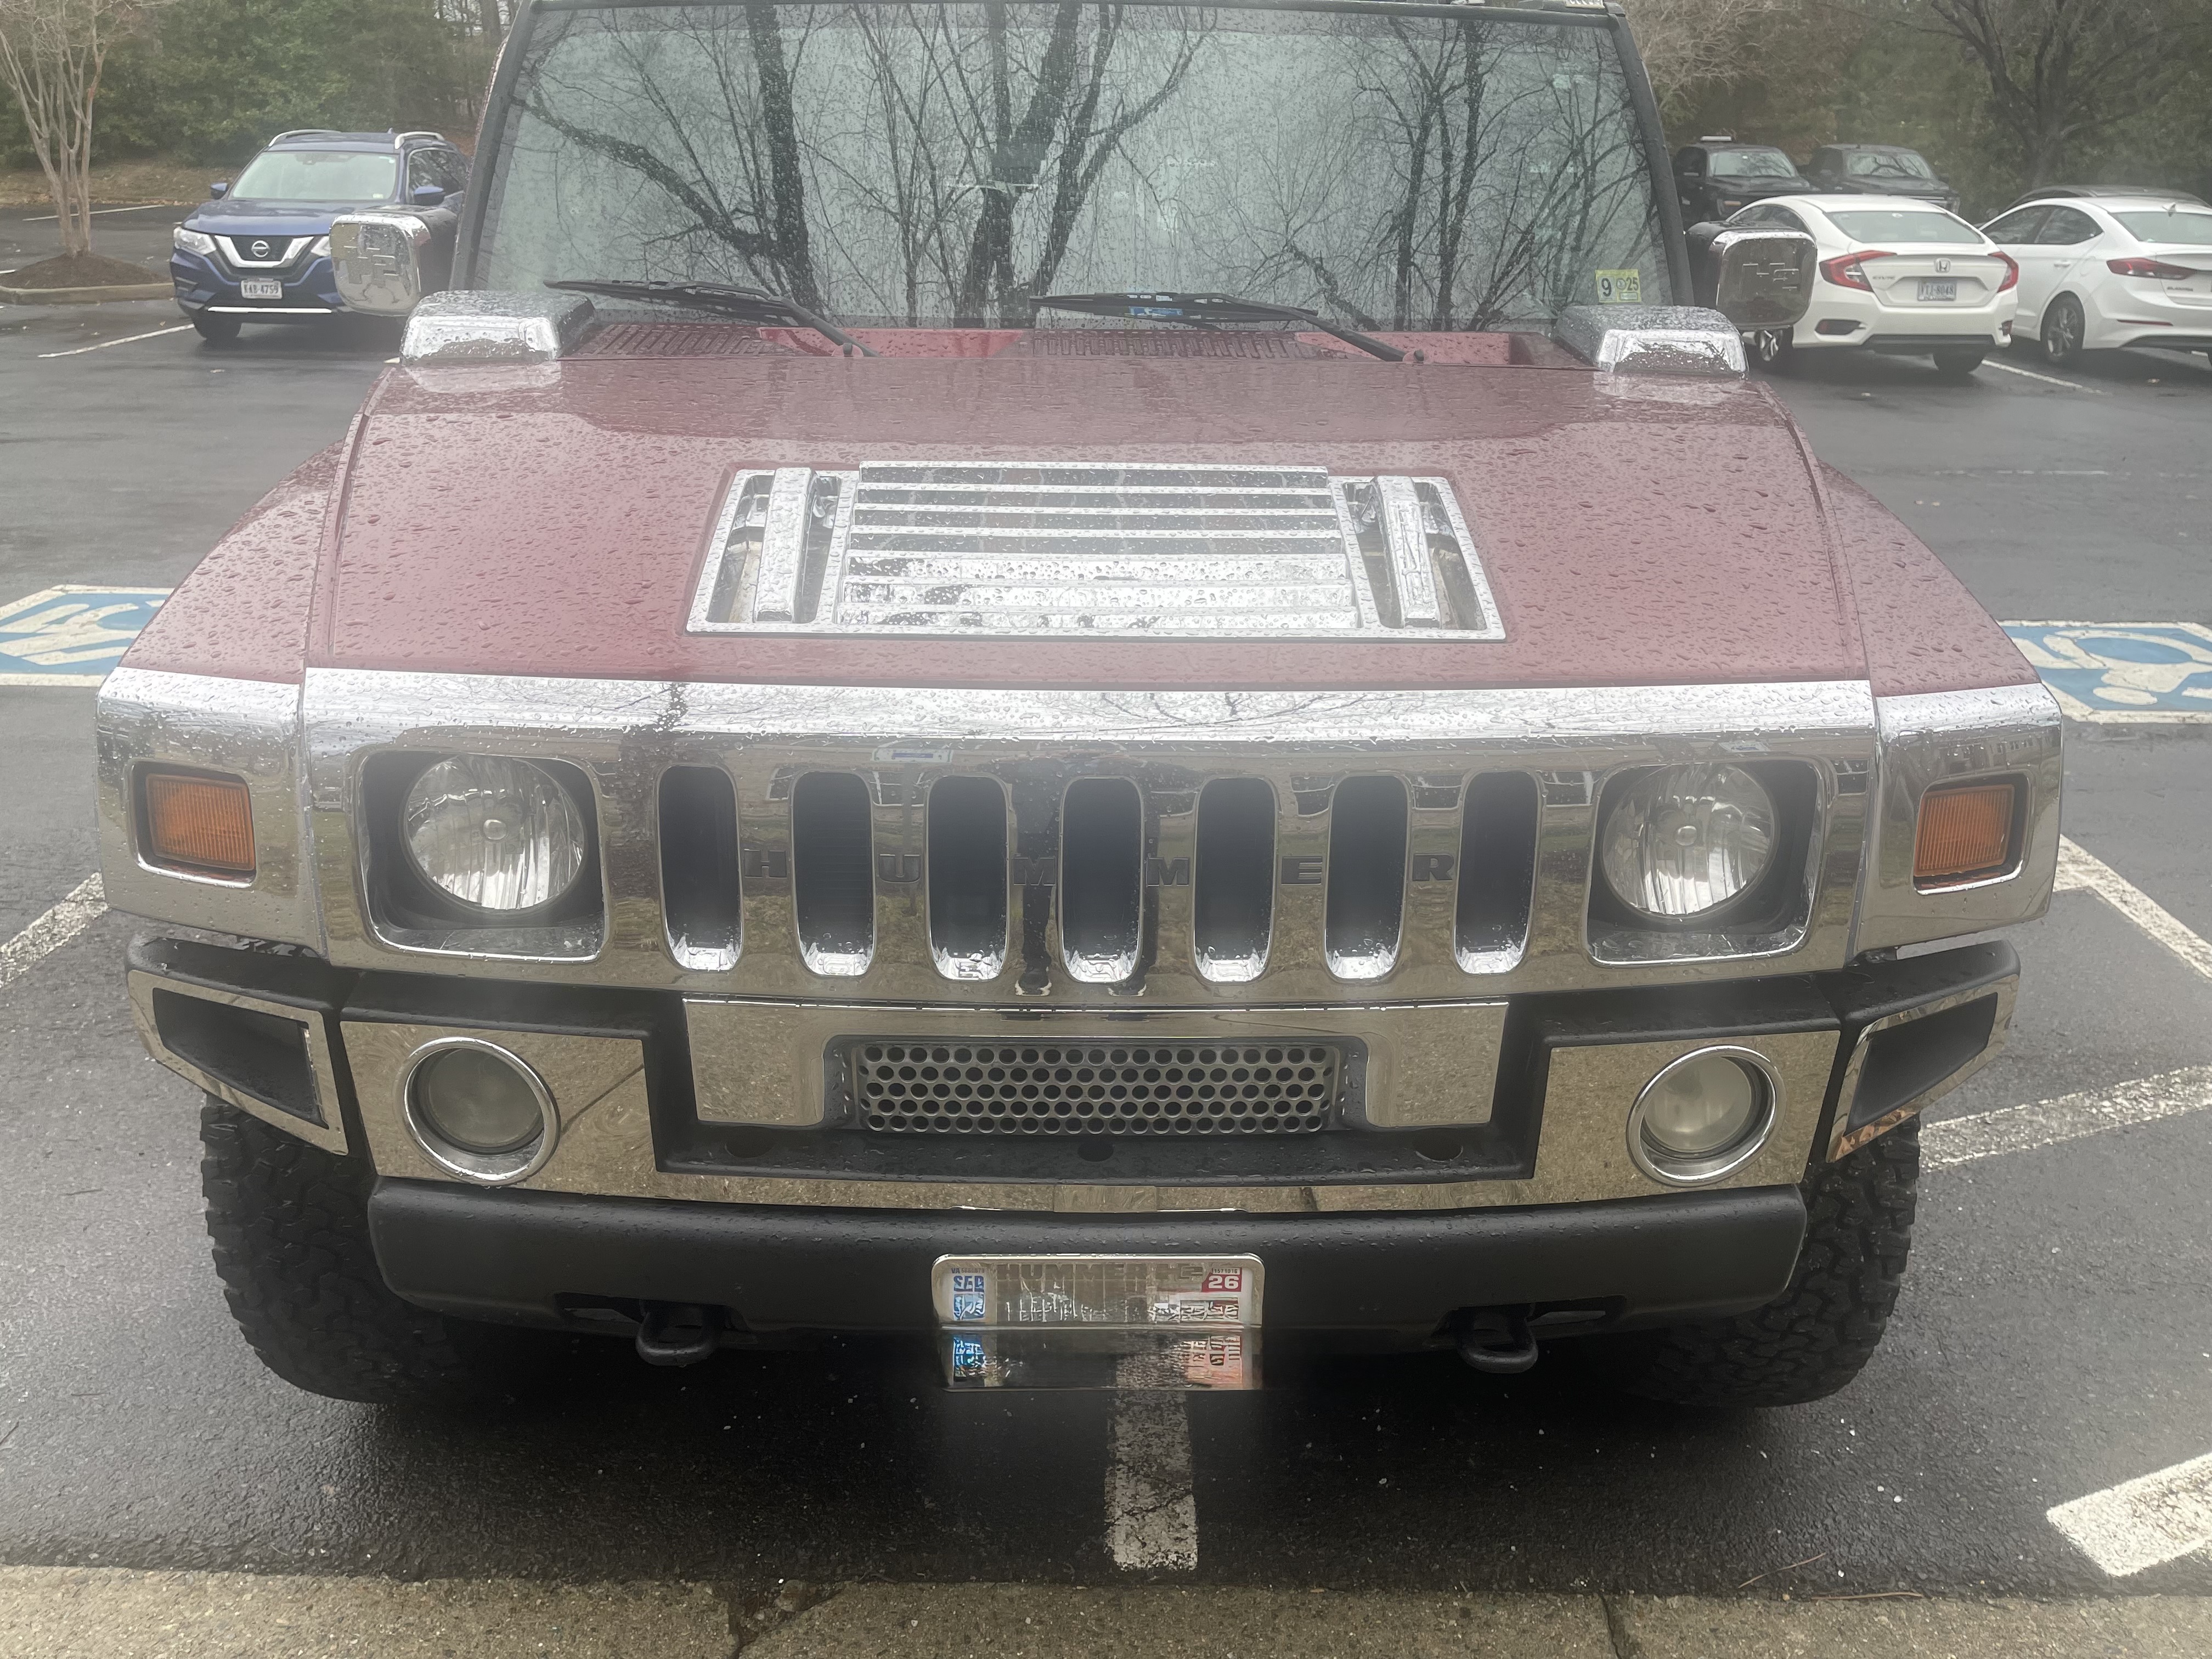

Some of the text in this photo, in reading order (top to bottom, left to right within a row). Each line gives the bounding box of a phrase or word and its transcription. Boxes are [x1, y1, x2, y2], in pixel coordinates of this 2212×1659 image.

[1601, 278, 1612, 297] 9
[1626, 276, 1639, 291] 25
[744, 848, 1455, 887] HUMMER
[997, 1263, 1148, 1280] HUMMER
[1209, 1276, 1239, 1289] 26
